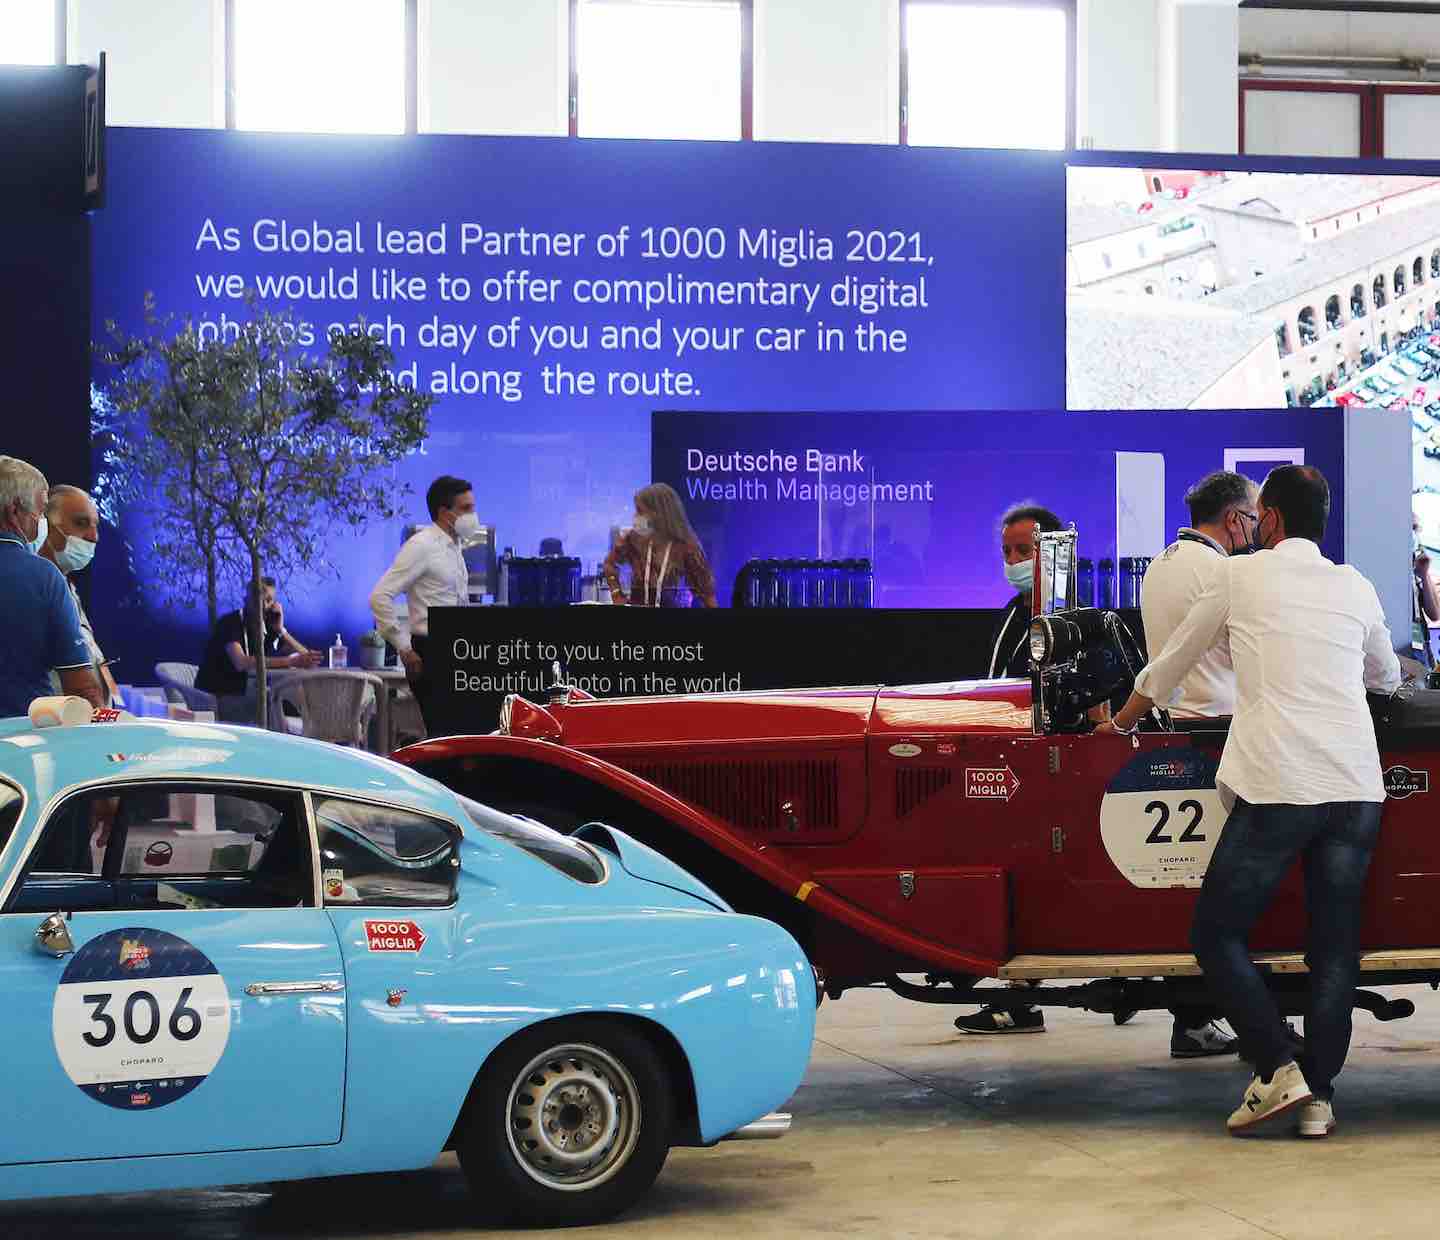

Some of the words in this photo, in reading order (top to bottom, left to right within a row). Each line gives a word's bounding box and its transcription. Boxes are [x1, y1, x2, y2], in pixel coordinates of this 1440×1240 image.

[196, 218, 241, 252] As
[253, 219, 365, 253] Global
[376, 221, 446, 255] lead
[461, 223, 584, 258] Partner
[597, 225, 629, 257] of
[640, 227, 726, 259] 1000
[738, 228, 833, 267] Miglia
[846, 230, 934, 266] 2021,
[196, 273, 245, 298] we
[256, 267, 358, 300] would
[372, 268, 426, 301] like
[437, 271, 471, 301] to
[483, 270, 562, 303] offer
[573, 273, 820, 313] complimentary
[830, 275, 929, 314] digital
[418, 315, 477, 356] day
[488, 316, 521, 348] of
[530, 324, 589, 356] you
[600, 318, 662, 350] and
[672, 325, 745, 357] your
[754, 326, 806, 352] car
[816, 321, 843, 352] in
[854, 321, 907, 352] the
[431, 362, 522, 402] along
[541, 364, 595, 395] the
[607, 366, 701, 396] route.
[687, 449, 798, 473] Deutsche
[806, 449, 865, 473] Bank
[686, 477, 768, 501] Wealth
[776, 477, 934, 507] Management
[453, 638, 491, 661] Our
[497, 639, 530, 665] gift
[537, 641, 557, 661] to
[564, 642, 605, 665] you.
[611, 640, 645, 662] the
[652, 641, 704, 662] most
[453, 670, 545, 693] Beautiful
[619, 672, 636, 693] in
[643, 672, 676, 694] the
[684, 672, 741, 694] world
[969, 785, 1008, 796] MIGLIA
[971, 772, 1005, 782] 1000
[1144, 799, 1206, 844] 22
[370, 923, 409, 934] 1000
[370, 938, 416, 949] MIGLIA
[82, 987, 202, 1047] 306
